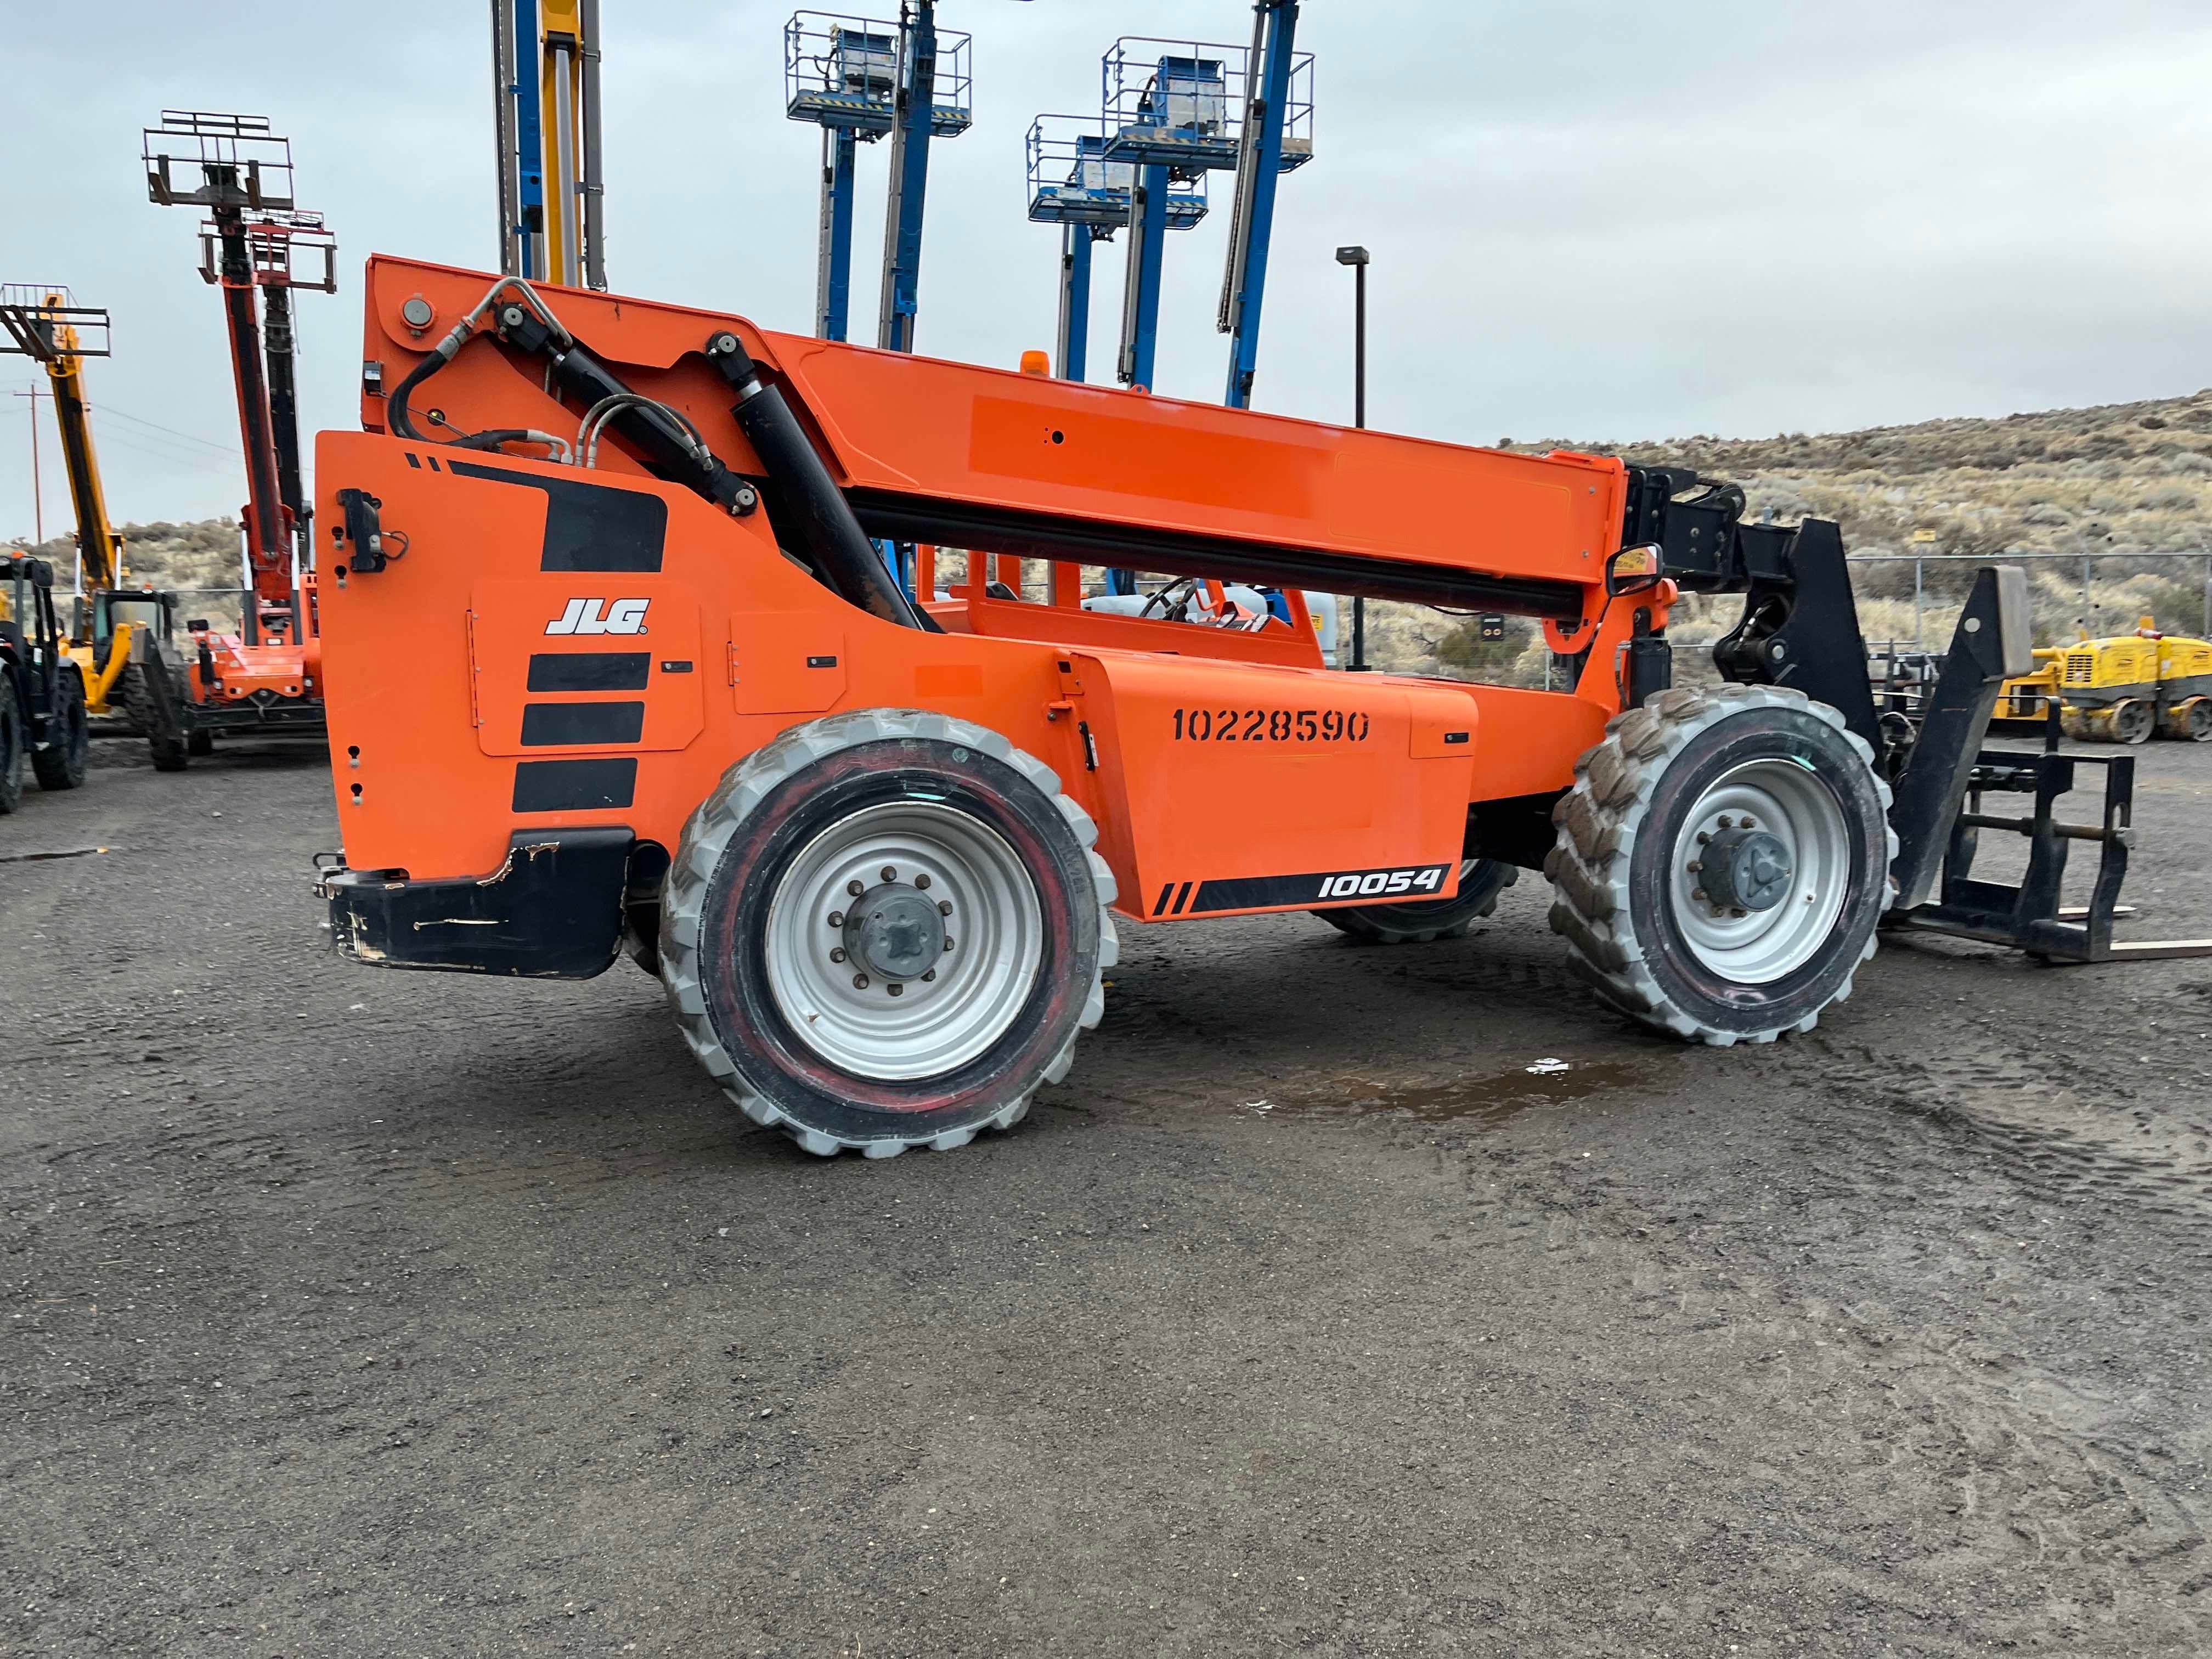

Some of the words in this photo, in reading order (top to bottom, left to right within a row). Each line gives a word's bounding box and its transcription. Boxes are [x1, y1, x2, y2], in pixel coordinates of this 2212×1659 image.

[544, 598, 651, 635] JLG
[1173, 709, 1369, 742] 10228590
[1317, 868, 1442, 898] 10054
